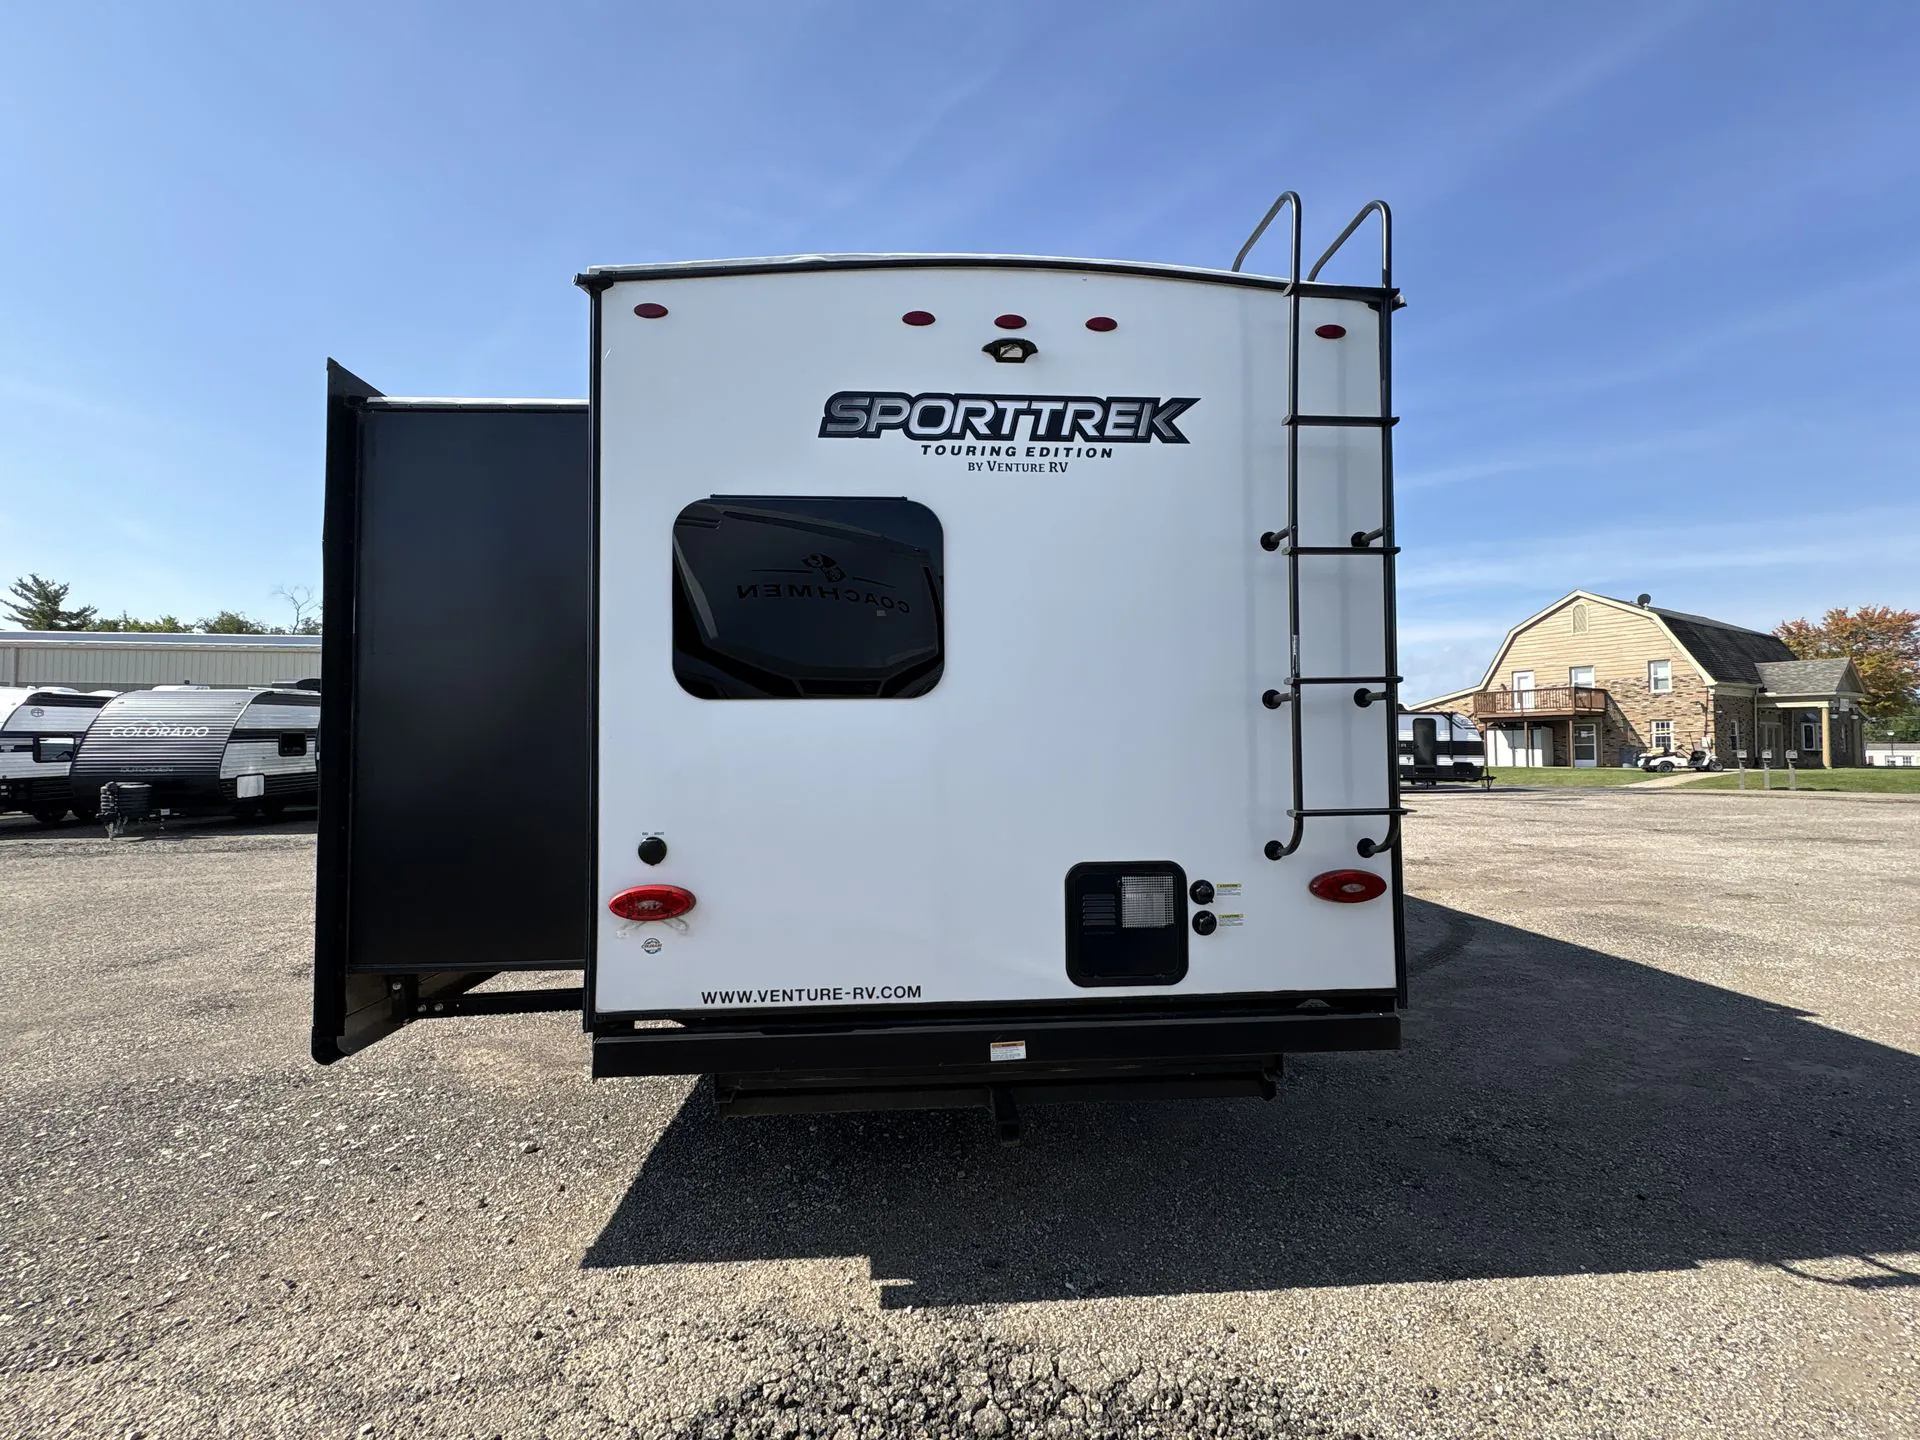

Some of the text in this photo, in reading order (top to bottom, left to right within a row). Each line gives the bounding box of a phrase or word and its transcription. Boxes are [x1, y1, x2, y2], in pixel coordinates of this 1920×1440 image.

[818, 391, 1201, 444] SPORTTREK
[921, 445, 1113, 458] TOURING EDITION
[967, 462, 984, 472] BY
[1048, 461, 1069, 473] RV
[110, 726, 209, 737] COLORADO
[700, 985, 922, 1004] WWW.VENTURE-RV.COM
